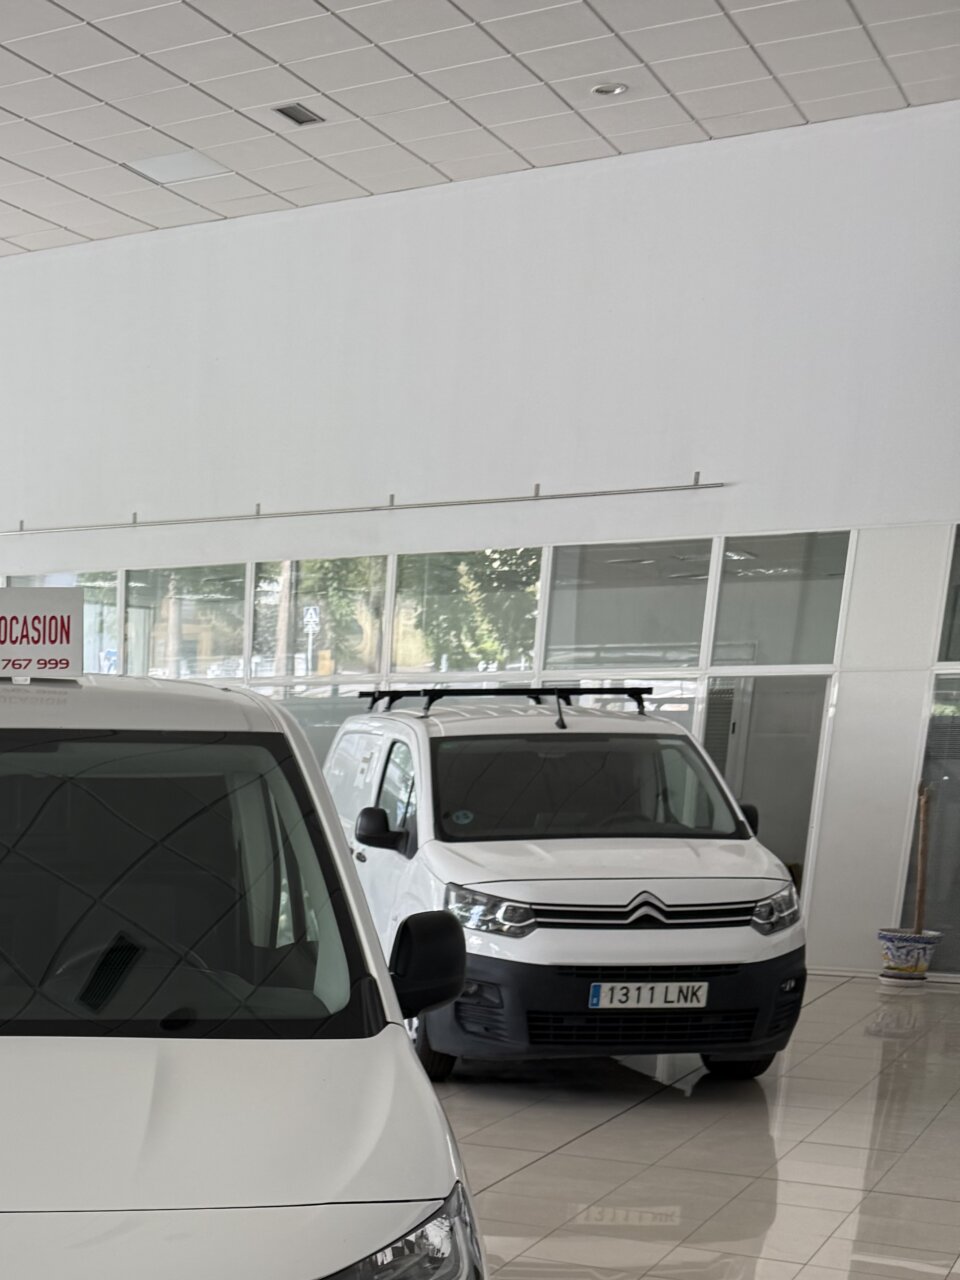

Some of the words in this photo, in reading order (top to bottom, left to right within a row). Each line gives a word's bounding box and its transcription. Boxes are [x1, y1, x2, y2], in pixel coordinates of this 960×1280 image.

[2, 658, 32, 670] 767
[37, 658, 70, 670] 999
[607, 985, 656, 1004] 1311
[663, 985, 702, 1004] LNK
